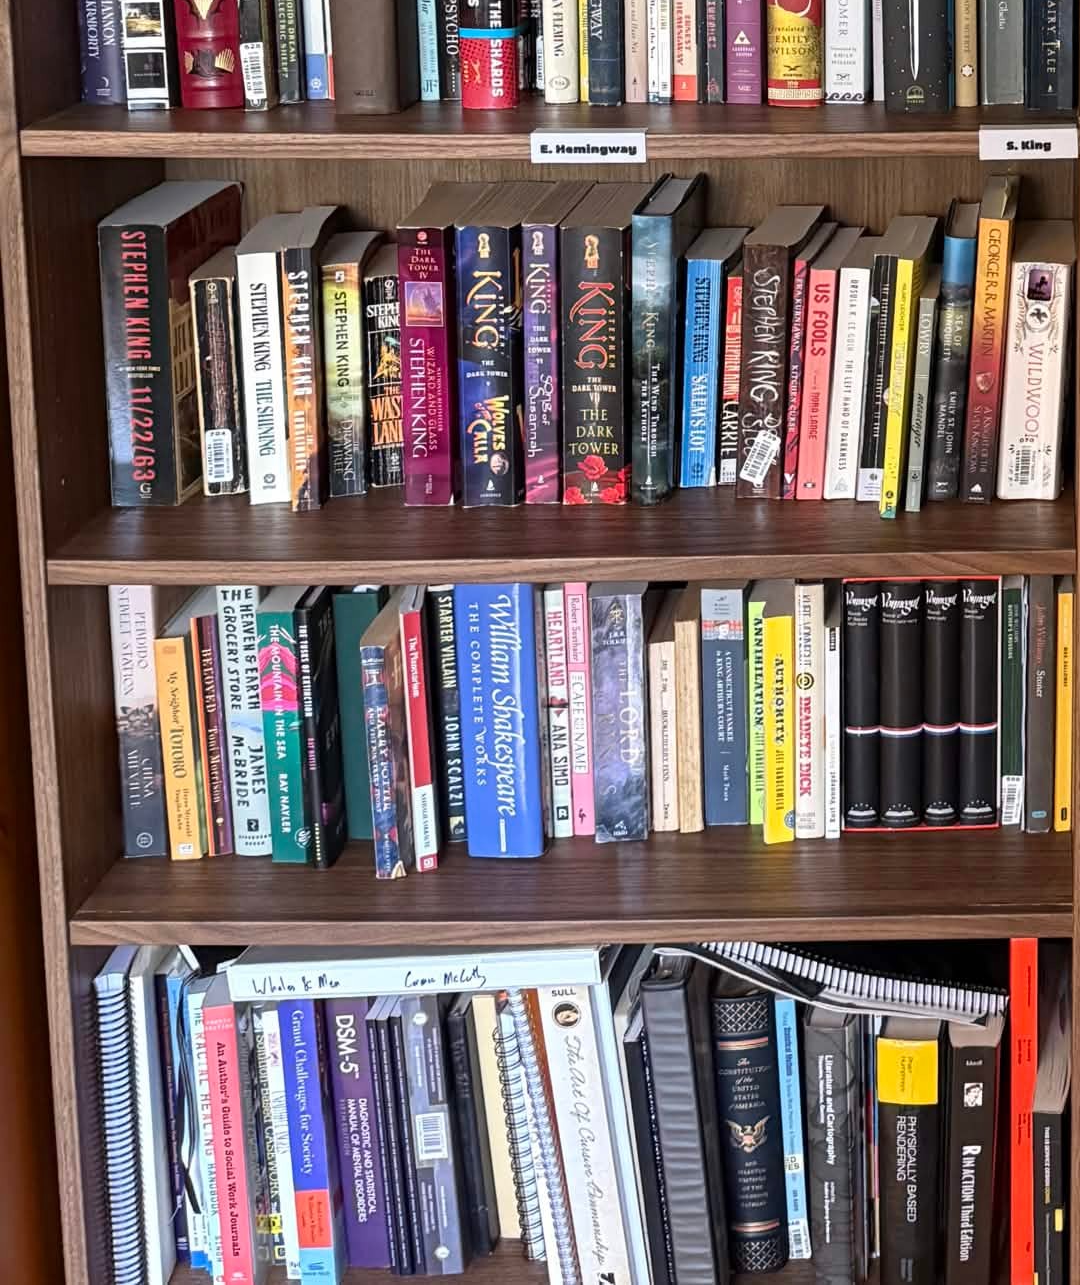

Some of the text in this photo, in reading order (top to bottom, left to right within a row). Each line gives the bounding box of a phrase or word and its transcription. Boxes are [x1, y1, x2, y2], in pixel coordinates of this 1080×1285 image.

[489, 1, 503, 98] THE SHARDS
[540, 144, 636, 157] E. Hemingway
[1006, 139, 1051, 153] S. King
[121, 232, 151, 360] STEPHEN KING
[570, 282, 614, 369] KING
[812, 283, 830, 356] US FOOLS
[334, 292, 350, 388] STEPHEN KING
[129, 386, 156, 481] 11/22/63
[569, 442, 618, 455] TOWER
[576, 425, 614, 437] DARK
[582, 409, 608, 421] THE
[488, 594, 523, 816] William Shakespeare
[774, 658, 784, 744] AUTHORITY
[232, 735, 249, 807] McBRIDE
[249, 746, 266, 795] JAMES
[800, 697, 811, 796] DEADEYE DICK
[336, 1015, 358, 1073] DSM-5
[897, 1116, 906, 1181] RENDERING
[907, 1116, 918, 1223] PHYSICALLY BASED
[224, 1150, 241, 1256] Social Work Journals
